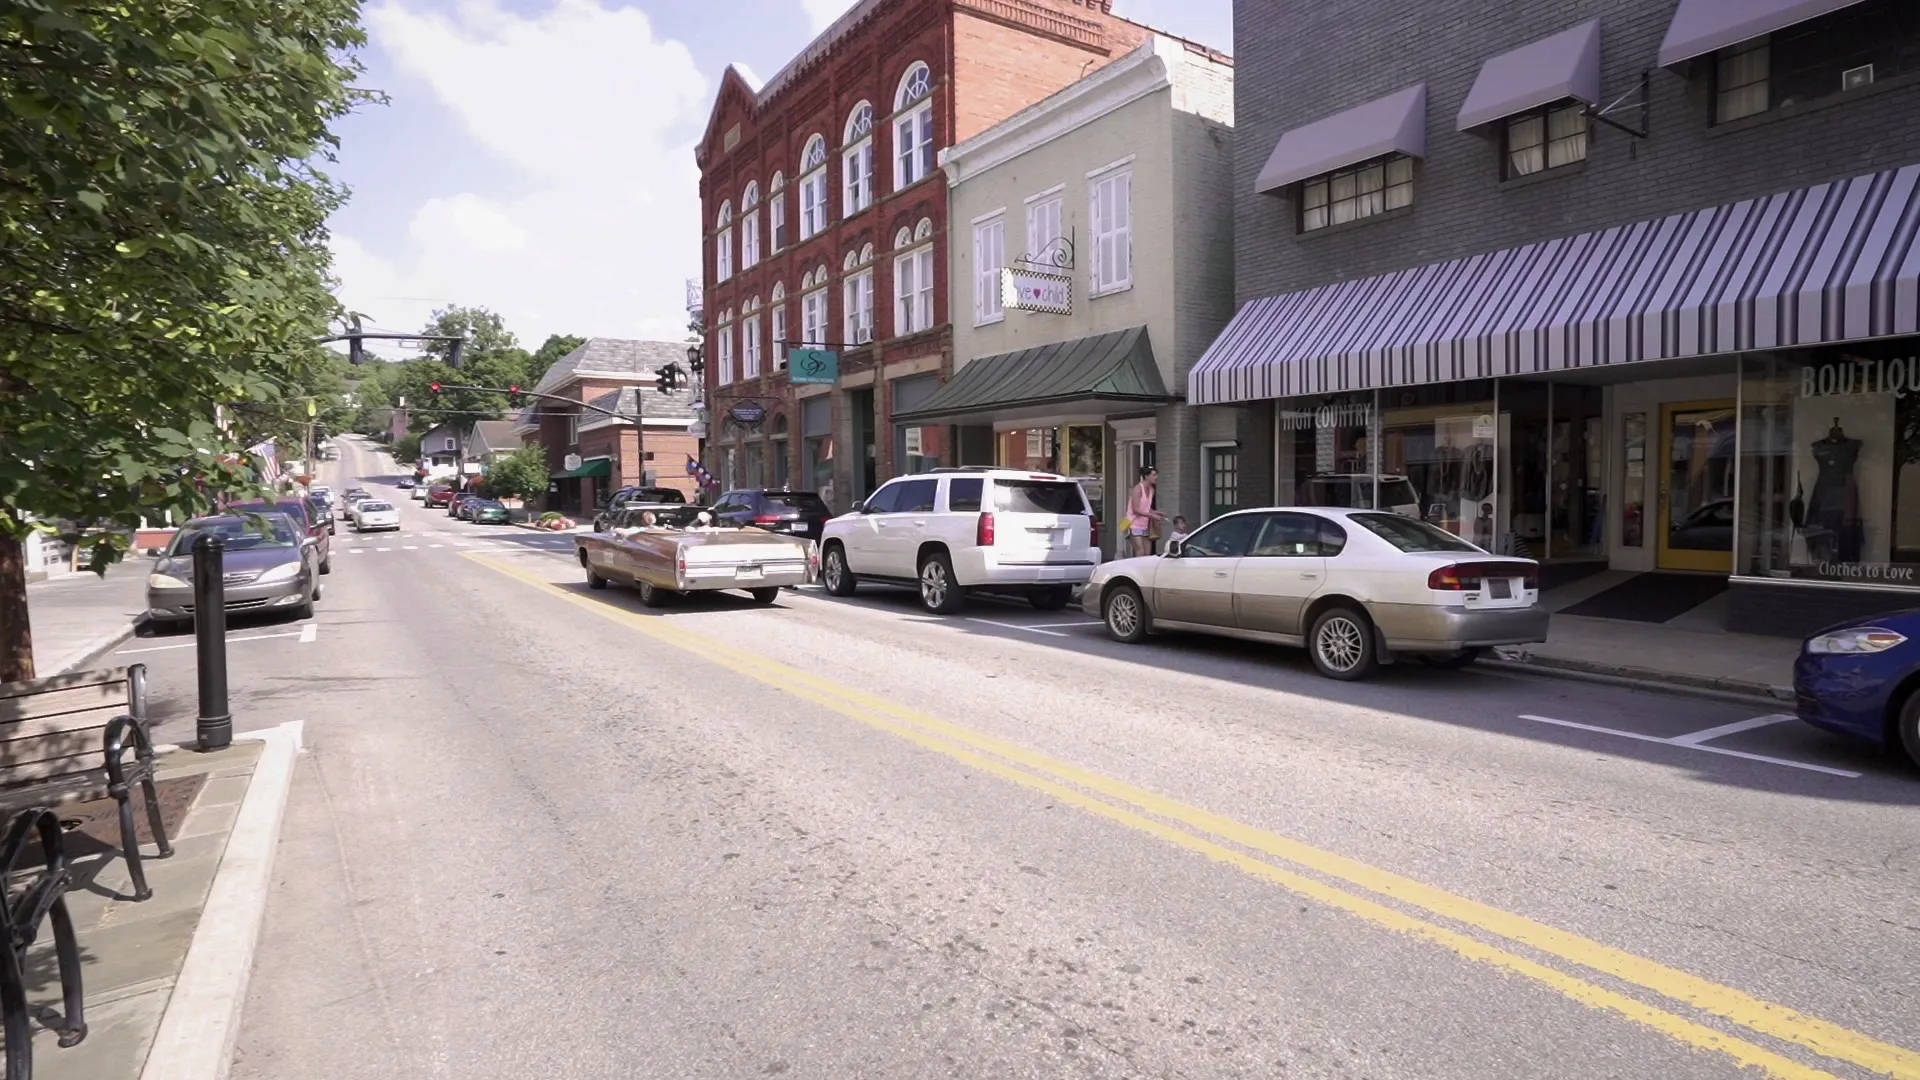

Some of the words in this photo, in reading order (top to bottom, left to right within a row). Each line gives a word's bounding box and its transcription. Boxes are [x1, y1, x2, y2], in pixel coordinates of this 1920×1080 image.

[1800, 356, 1920, 399] BOUTIQU
[1315, 402, 1371, 429] COUNTRY
[1818, 561, 1862, 577] Clothes
[1866, 563, 1880, 578] to
[1883, 563, 1914, 580] Love
